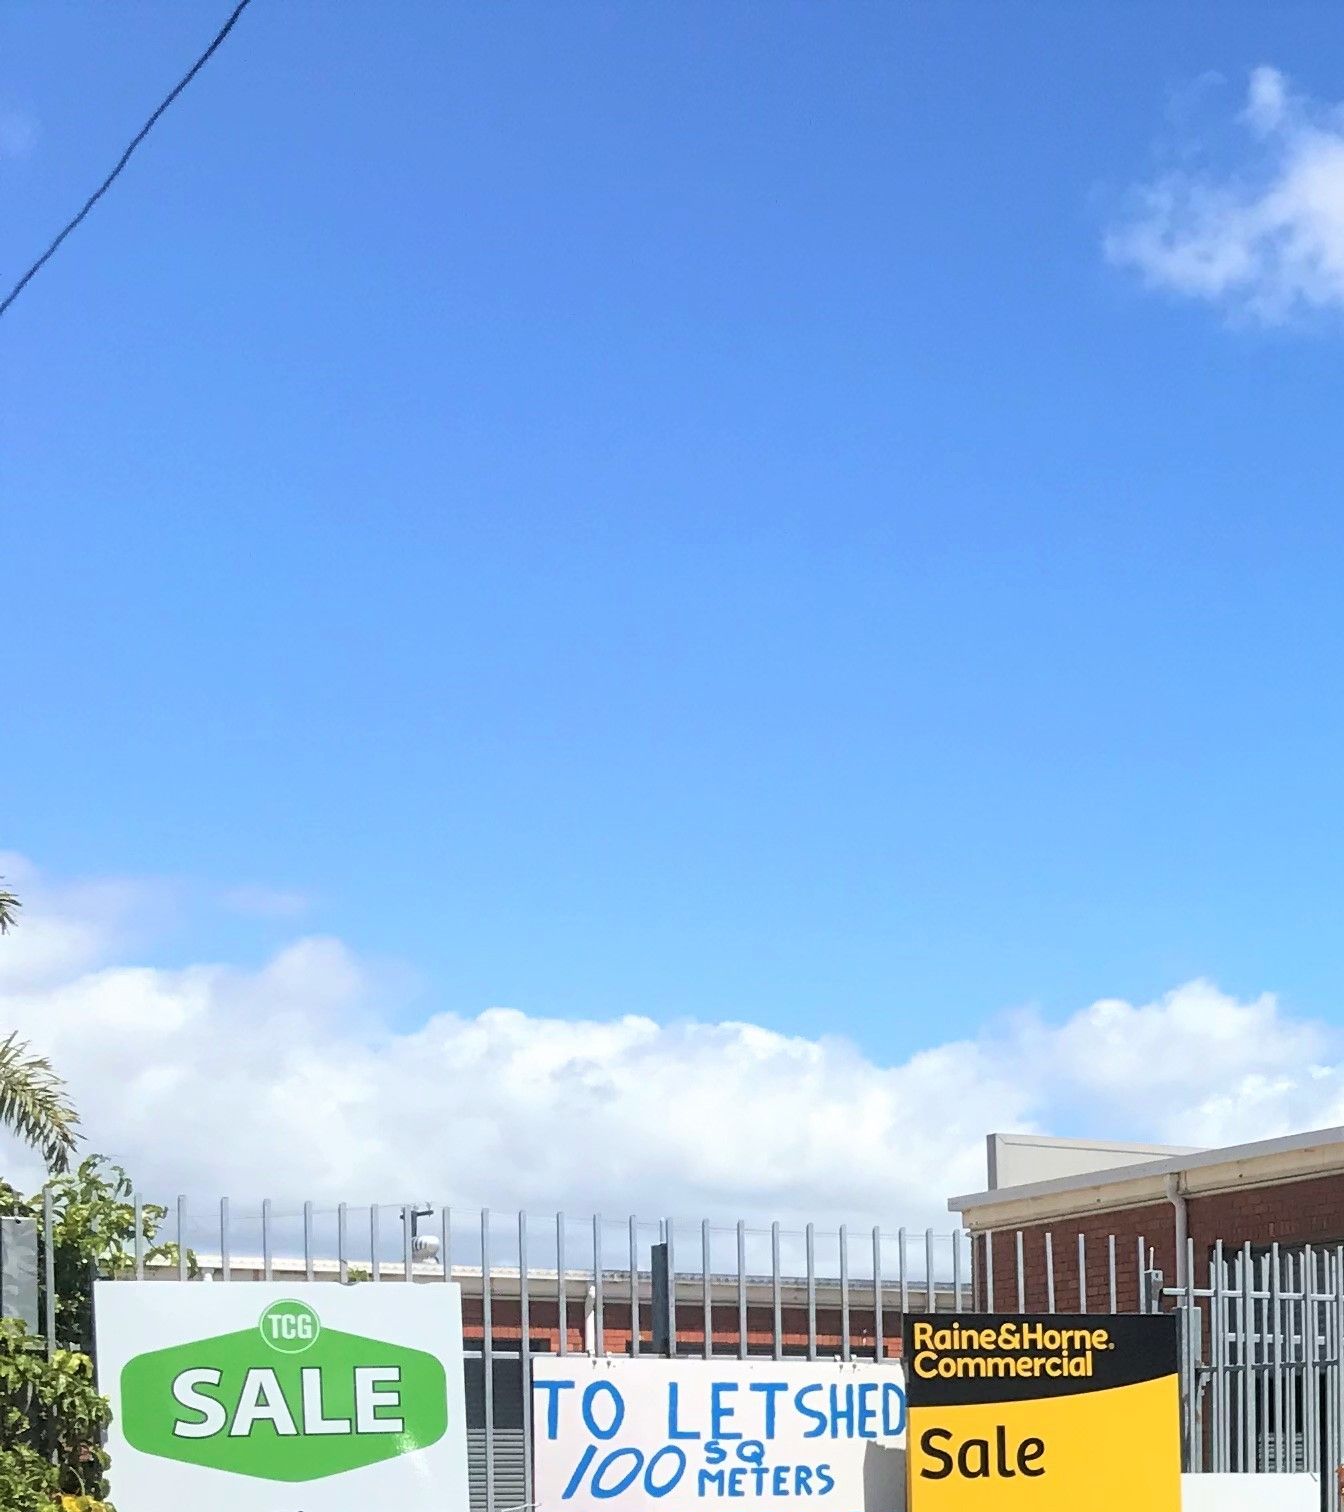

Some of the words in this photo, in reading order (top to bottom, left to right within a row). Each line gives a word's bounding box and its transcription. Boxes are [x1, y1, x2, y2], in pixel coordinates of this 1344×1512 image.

[267, 1313, 312, 1340] TCG
[913, 1350, 1093, 1379] Commercial
[171, 1365, 405, 1439] SALE
[533, 1379, 625, 1441] TO
[667, 1381, 789, 1441] LET
[794, 1382, 907, 1439] SHED
[562, 1443, 686, 1500] 100
[703, 1439, 765, 1466] SQ
[919, 1424, 1046, 1480] Sale
[697, 1463, 836, 1498] METERS
